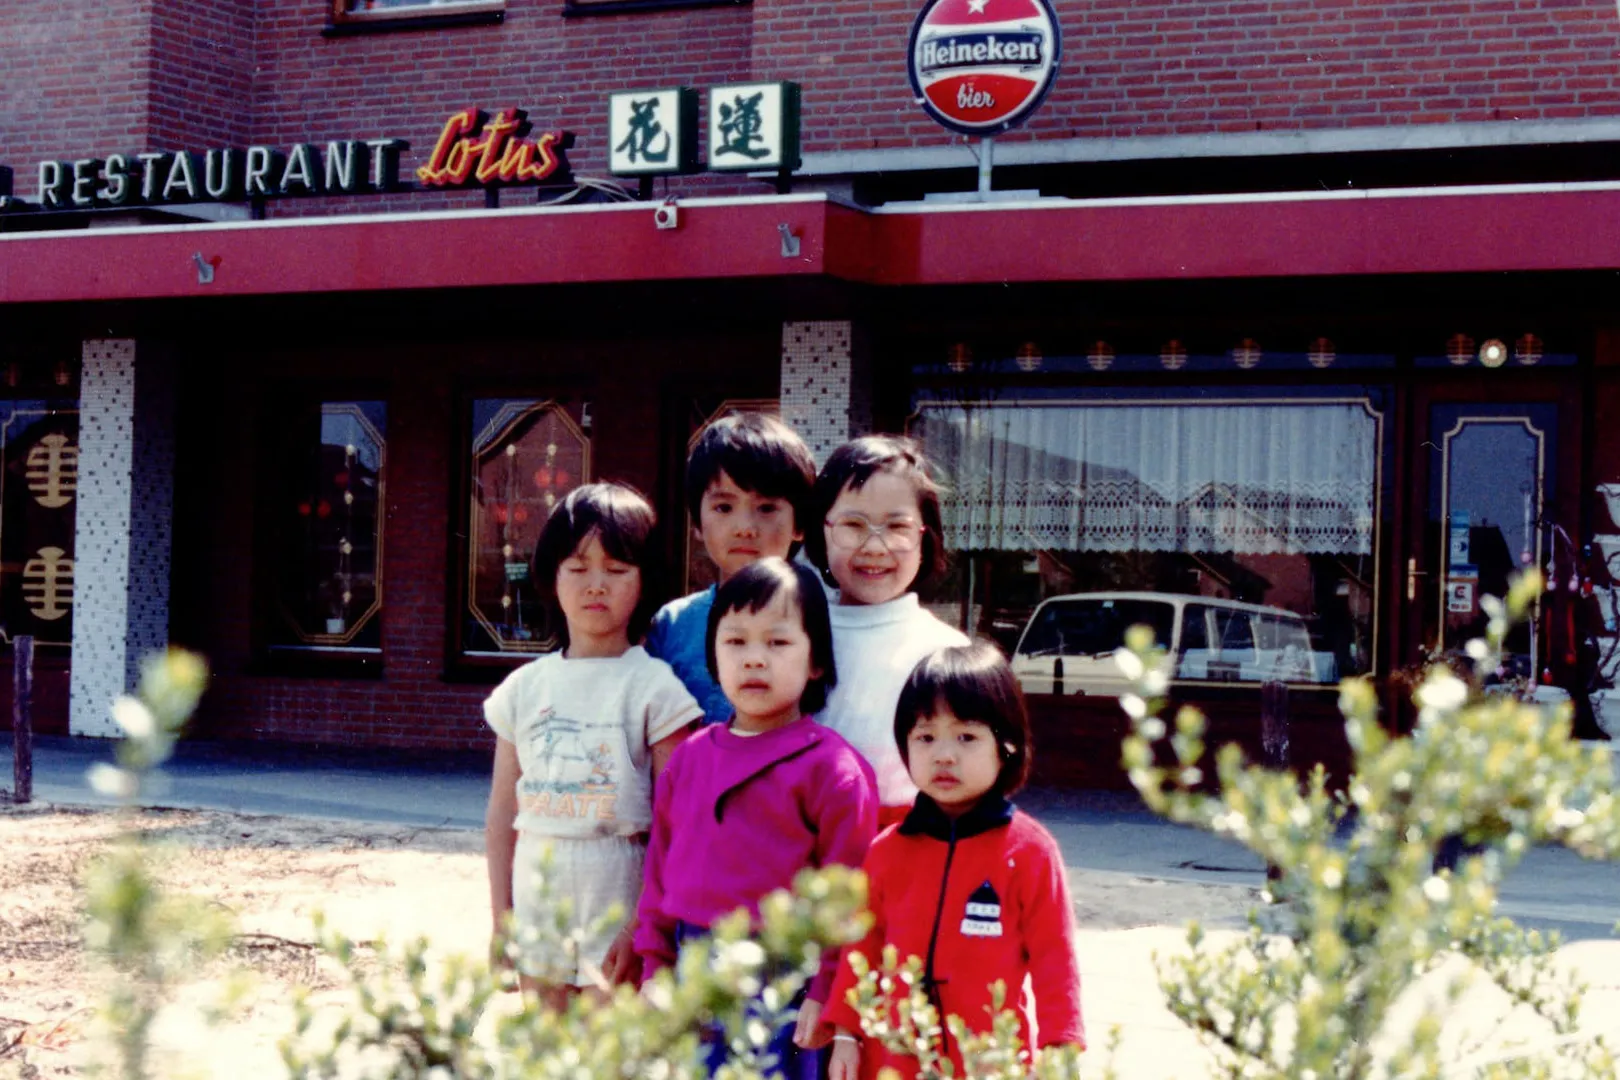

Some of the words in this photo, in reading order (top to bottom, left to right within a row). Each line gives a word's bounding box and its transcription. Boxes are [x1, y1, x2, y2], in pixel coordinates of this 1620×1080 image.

[922, 35, 1038, 68] Heineken
[957, 81, 995, 109] bier
[37, 138, 397, 207] RESTAURANT
[416, 107, 570, 187] Lotus
